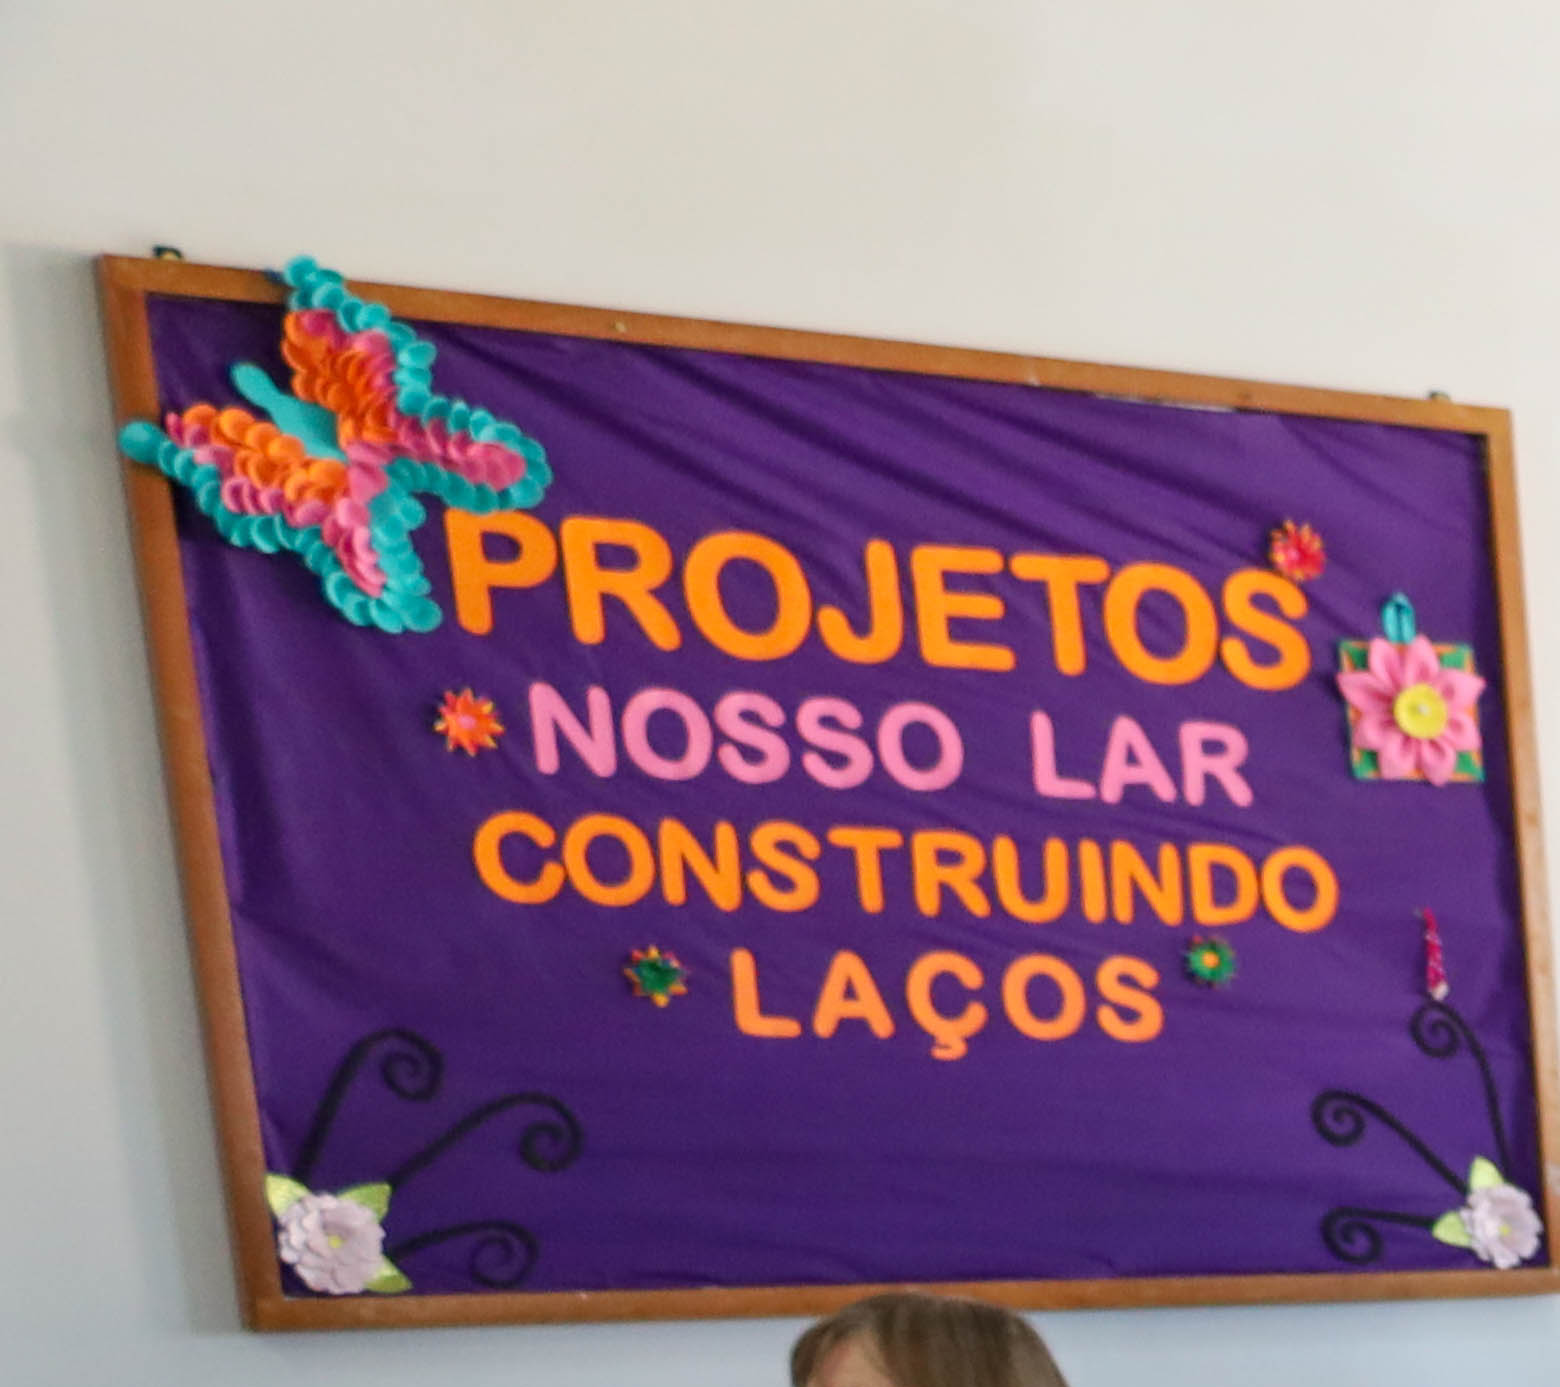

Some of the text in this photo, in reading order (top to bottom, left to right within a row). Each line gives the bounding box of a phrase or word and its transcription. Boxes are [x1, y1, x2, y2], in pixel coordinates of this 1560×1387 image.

[445, 509, 1309, 690] PROJETOS
[528, 683, 1253, 807] NOSSO LAR
[473, 811, 1337, 932] CONSTRUINDO
[731, 949, 1163, 1060] LAÇOS
